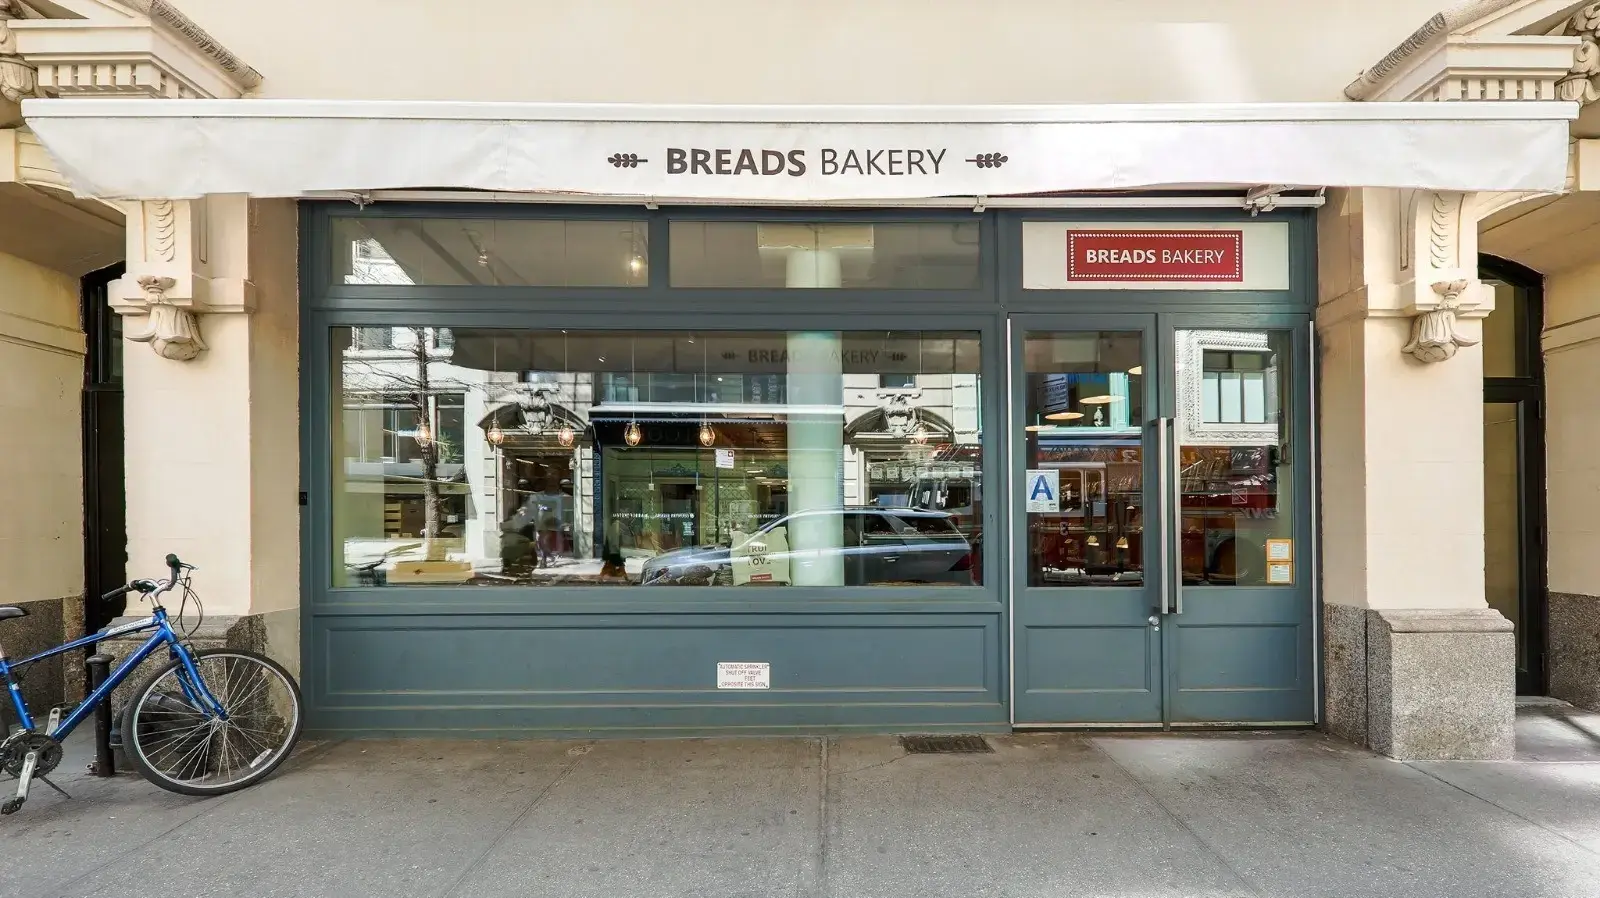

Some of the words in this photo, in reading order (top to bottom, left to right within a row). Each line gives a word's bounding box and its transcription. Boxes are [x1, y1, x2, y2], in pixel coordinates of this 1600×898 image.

[666, 148, 807, 176] BREADS
[821, 148, 947, 176] BAKERY
[1086, 249, 1156, 264] BREADS
[1162, 249, 1225, 264] BAKERY
[748, 348, 805, 364] BREAD
[827, 348, 879, 364] AKERY
[1030, 475, 1054, 500] A
